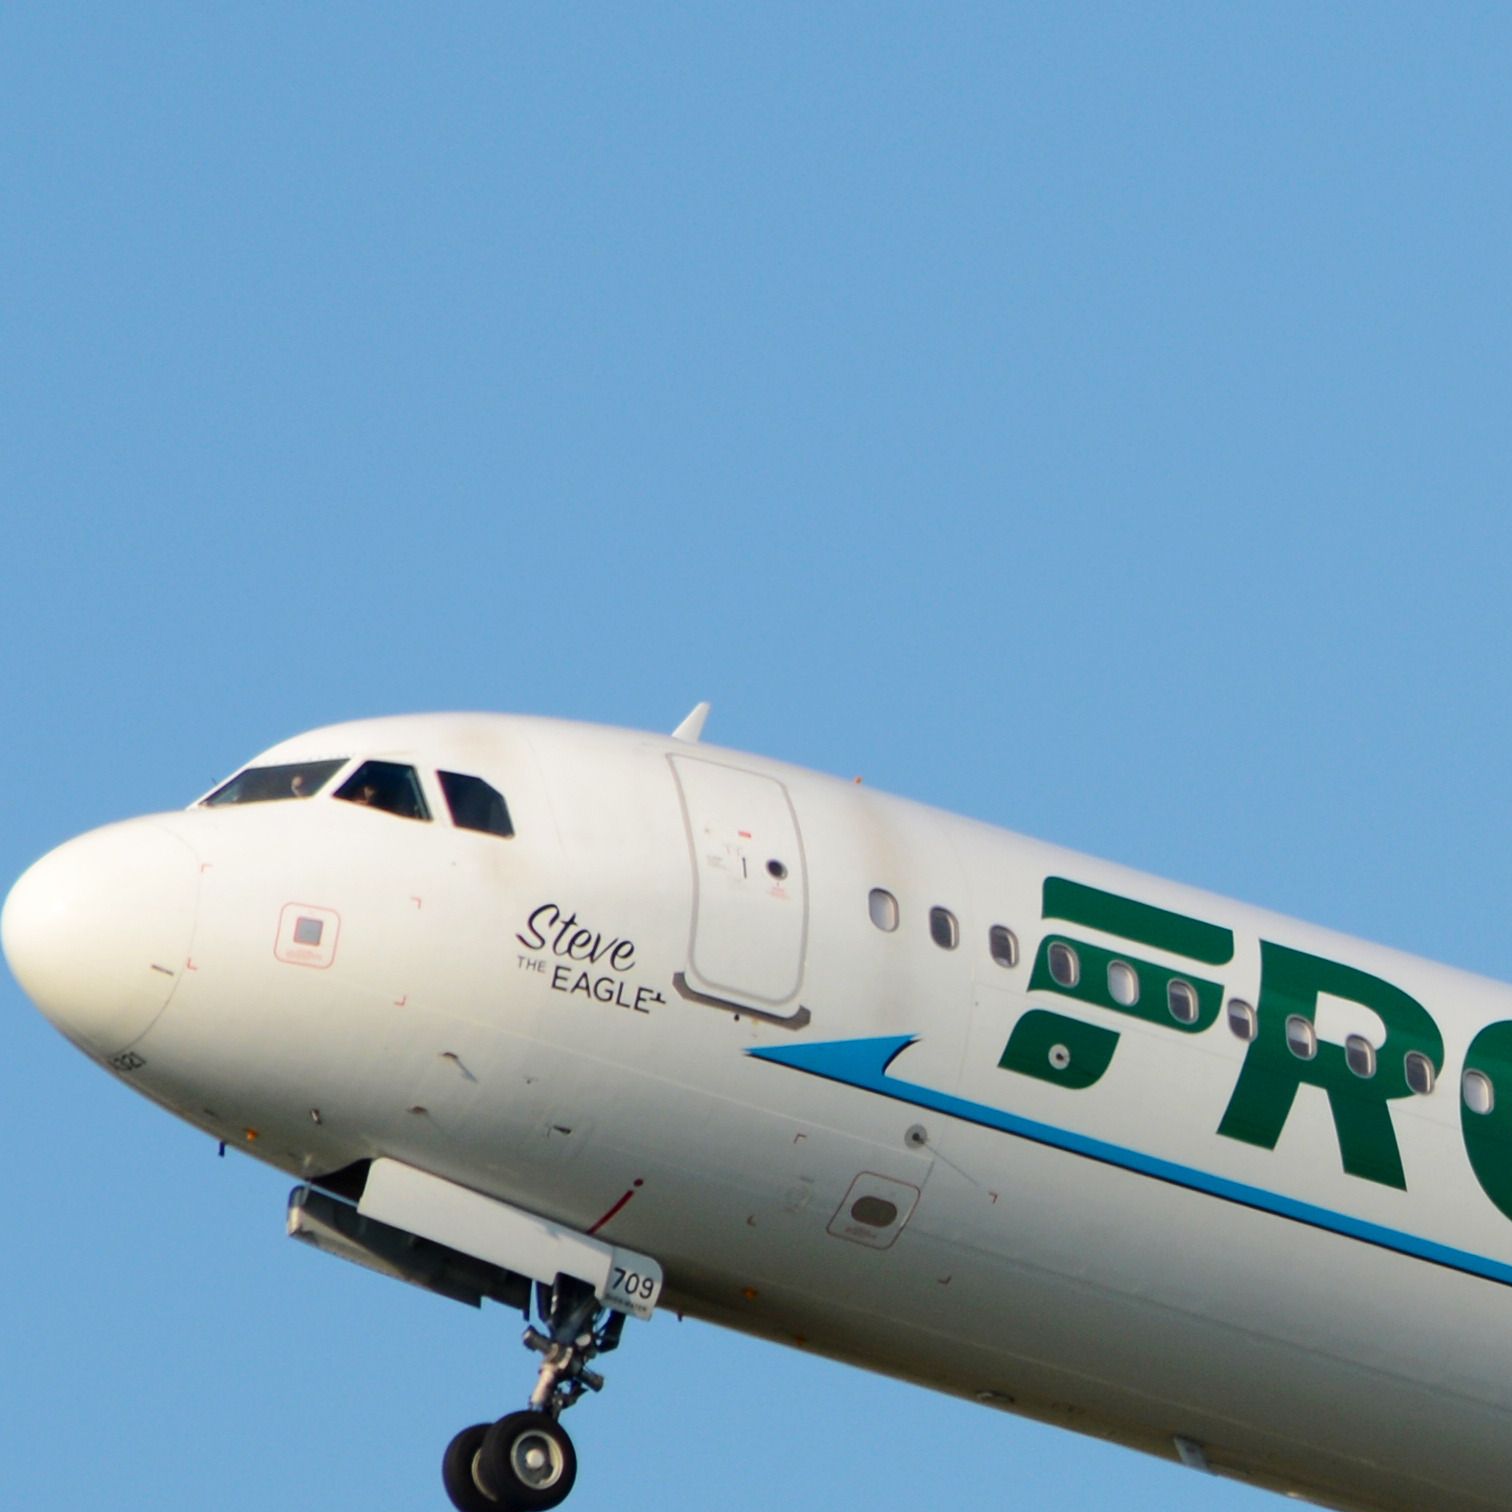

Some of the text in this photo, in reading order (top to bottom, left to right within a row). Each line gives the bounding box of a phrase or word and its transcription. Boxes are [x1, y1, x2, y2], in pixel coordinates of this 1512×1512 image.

[516, 903, 636, 972] Steve
[516, 955, 650, 1014] THE EAGLE
[612, 1267, 654, 1299] 709
